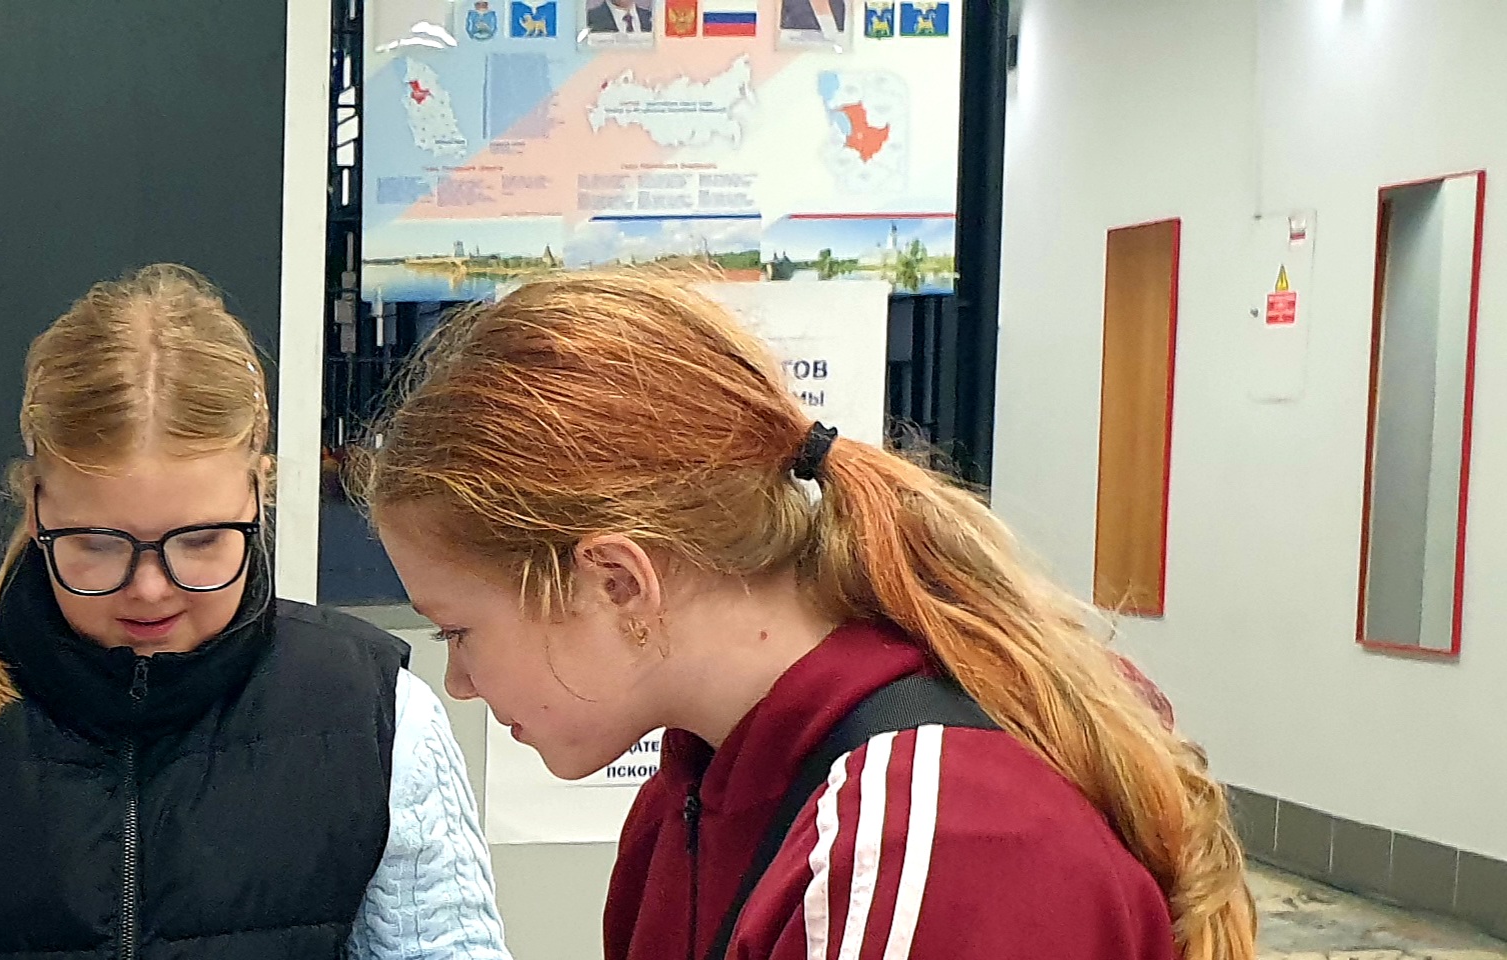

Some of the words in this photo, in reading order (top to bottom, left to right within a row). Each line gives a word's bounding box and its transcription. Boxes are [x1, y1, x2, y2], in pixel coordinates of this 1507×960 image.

[781, 360, 828, 379] ТОВ
[792, 391, 824, 406] МЫ
[607, 765, 658, 778] ПСКОВ
